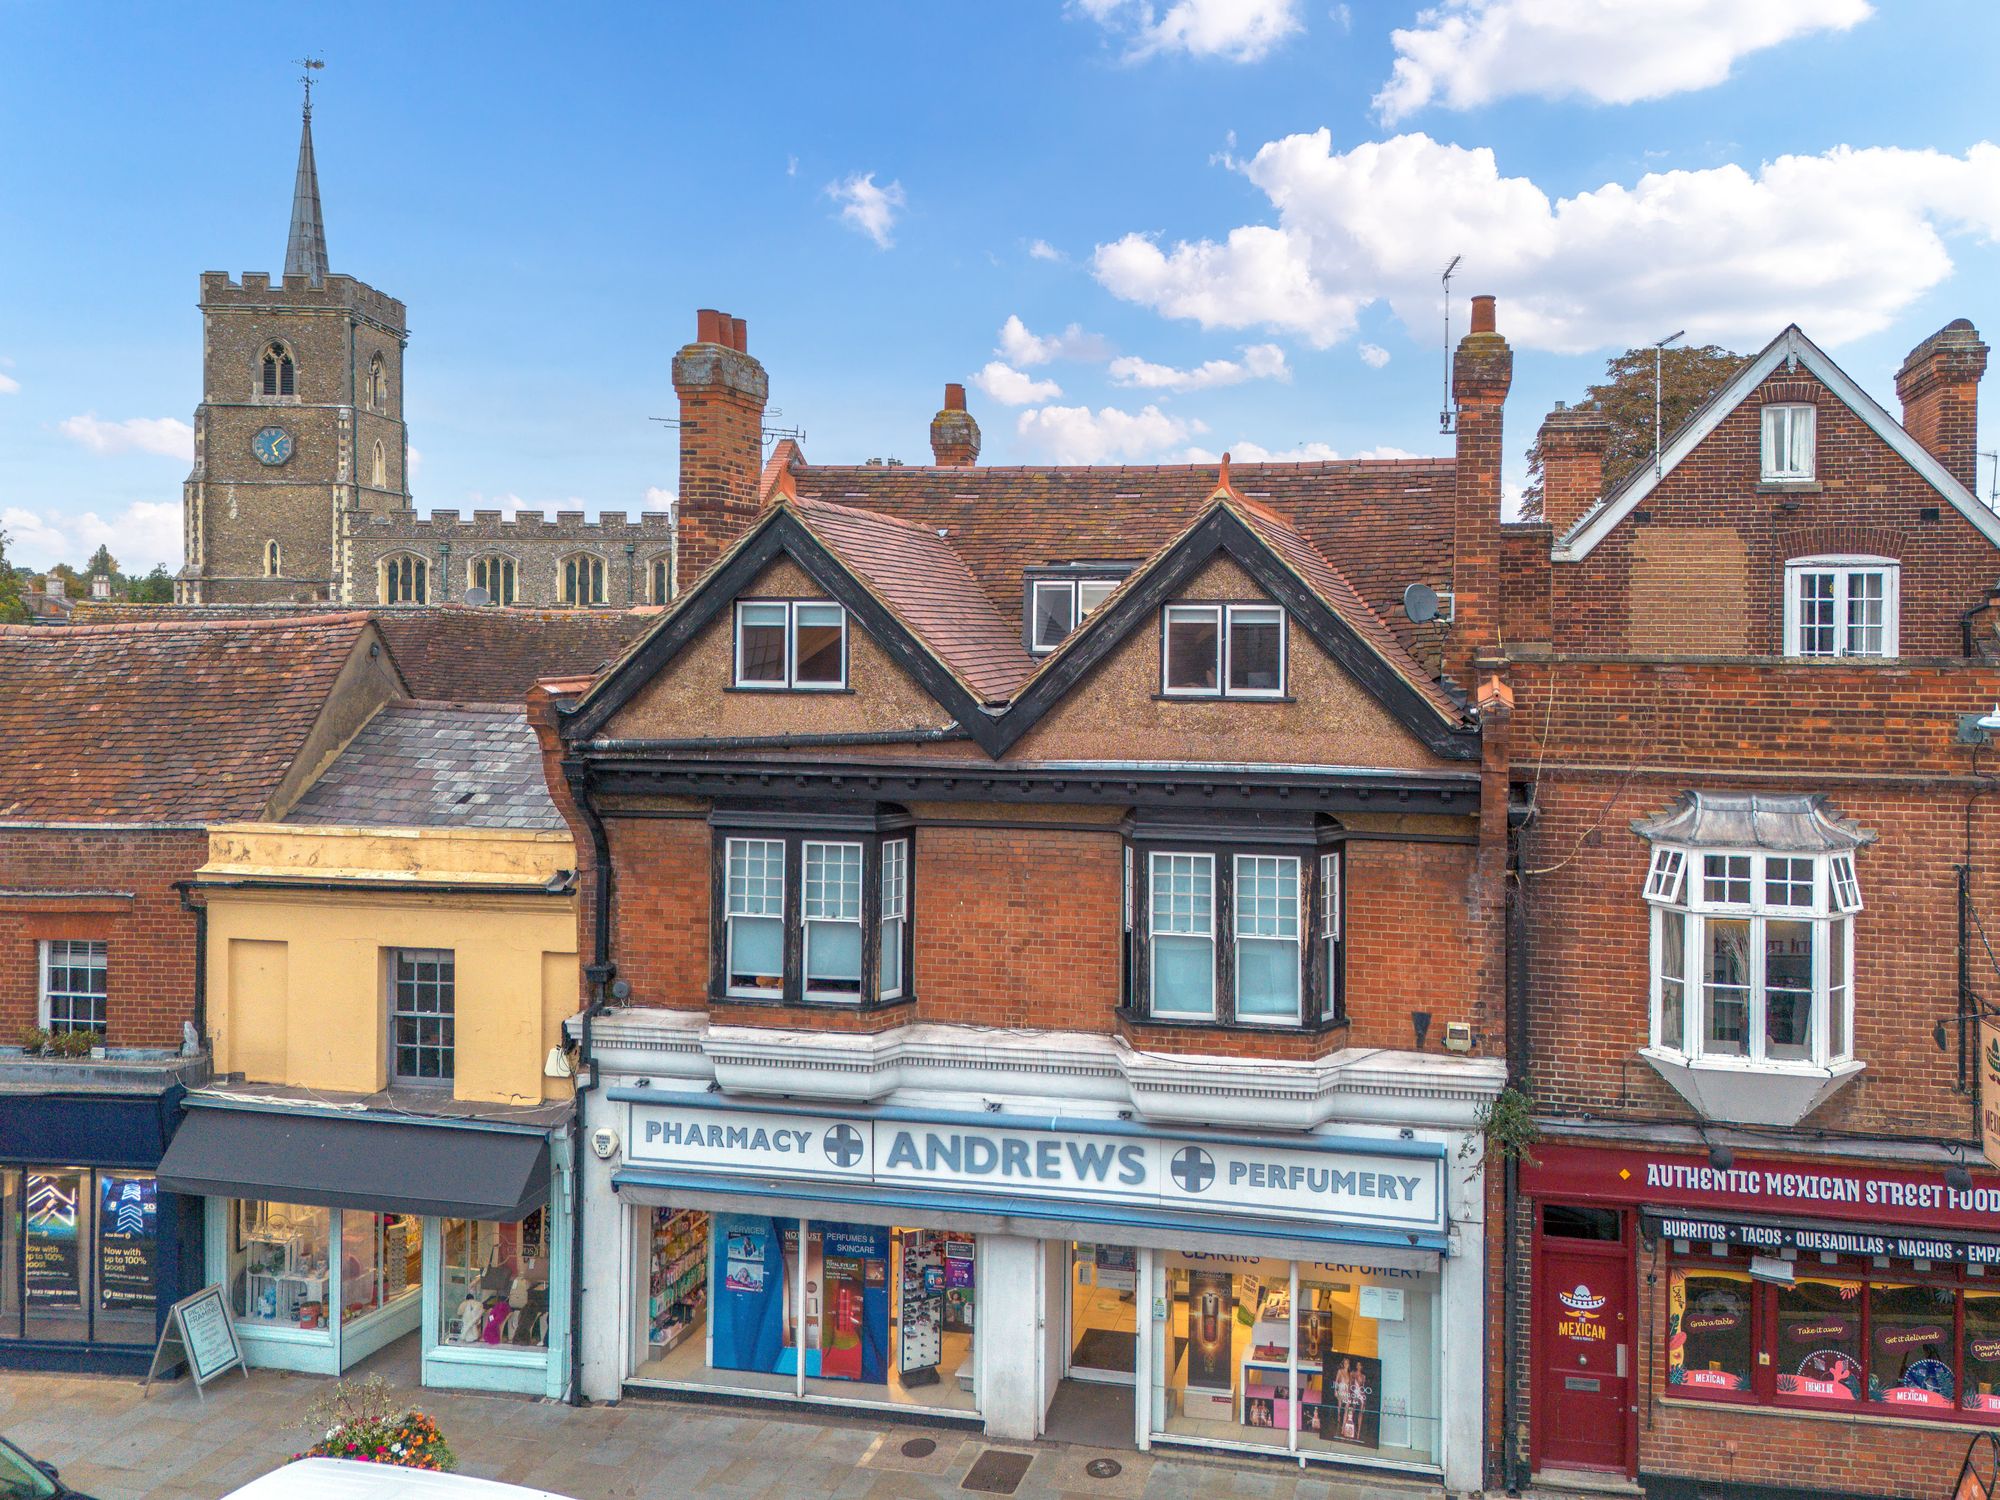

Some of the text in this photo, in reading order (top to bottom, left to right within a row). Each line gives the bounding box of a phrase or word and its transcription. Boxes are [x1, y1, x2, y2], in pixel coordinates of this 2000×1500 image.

[646, 1120, 812, 1153] PHARMACY
[886, 1131, 1146, 1185] ANDREWS
[1229, 1161, 1421, 1201] PERFUMERY
[1647, 1163, 2000, 1212] AUTHENTIC MEXICAN STREET FOOD
[729, 1225, 765, 1235] SERVICES
[826, 1232, 875, 1244] PERFUMES &
[1663, 1220, 1726, 1240] BURRITOS
[1741, 1226, 1782, 1245] TACOS
[1796, 1231, 1884, 1253] QUESADILLAS
[1899, 1239, 1952, 1259] NACHOS
[104, 1246, 141, 1257] Now with
[836, 1244, 875, 1254] SKINCARE
[104, 1256, 147, 1265] up to 100%
[1690, 1319, 1709, 1328] Grab
[1715, 1318, 1735, 1326] table
[1559, 1322, 1606, 1340] MEXICAN
[1797, 1326, 1843, 1335] Take it away
[1905, 1332, 1940, 1342] delivered
[1695, 1374, 1726, 1386] MEXICAN
[1896, 1391, 1928, 1403] MEXICAN
